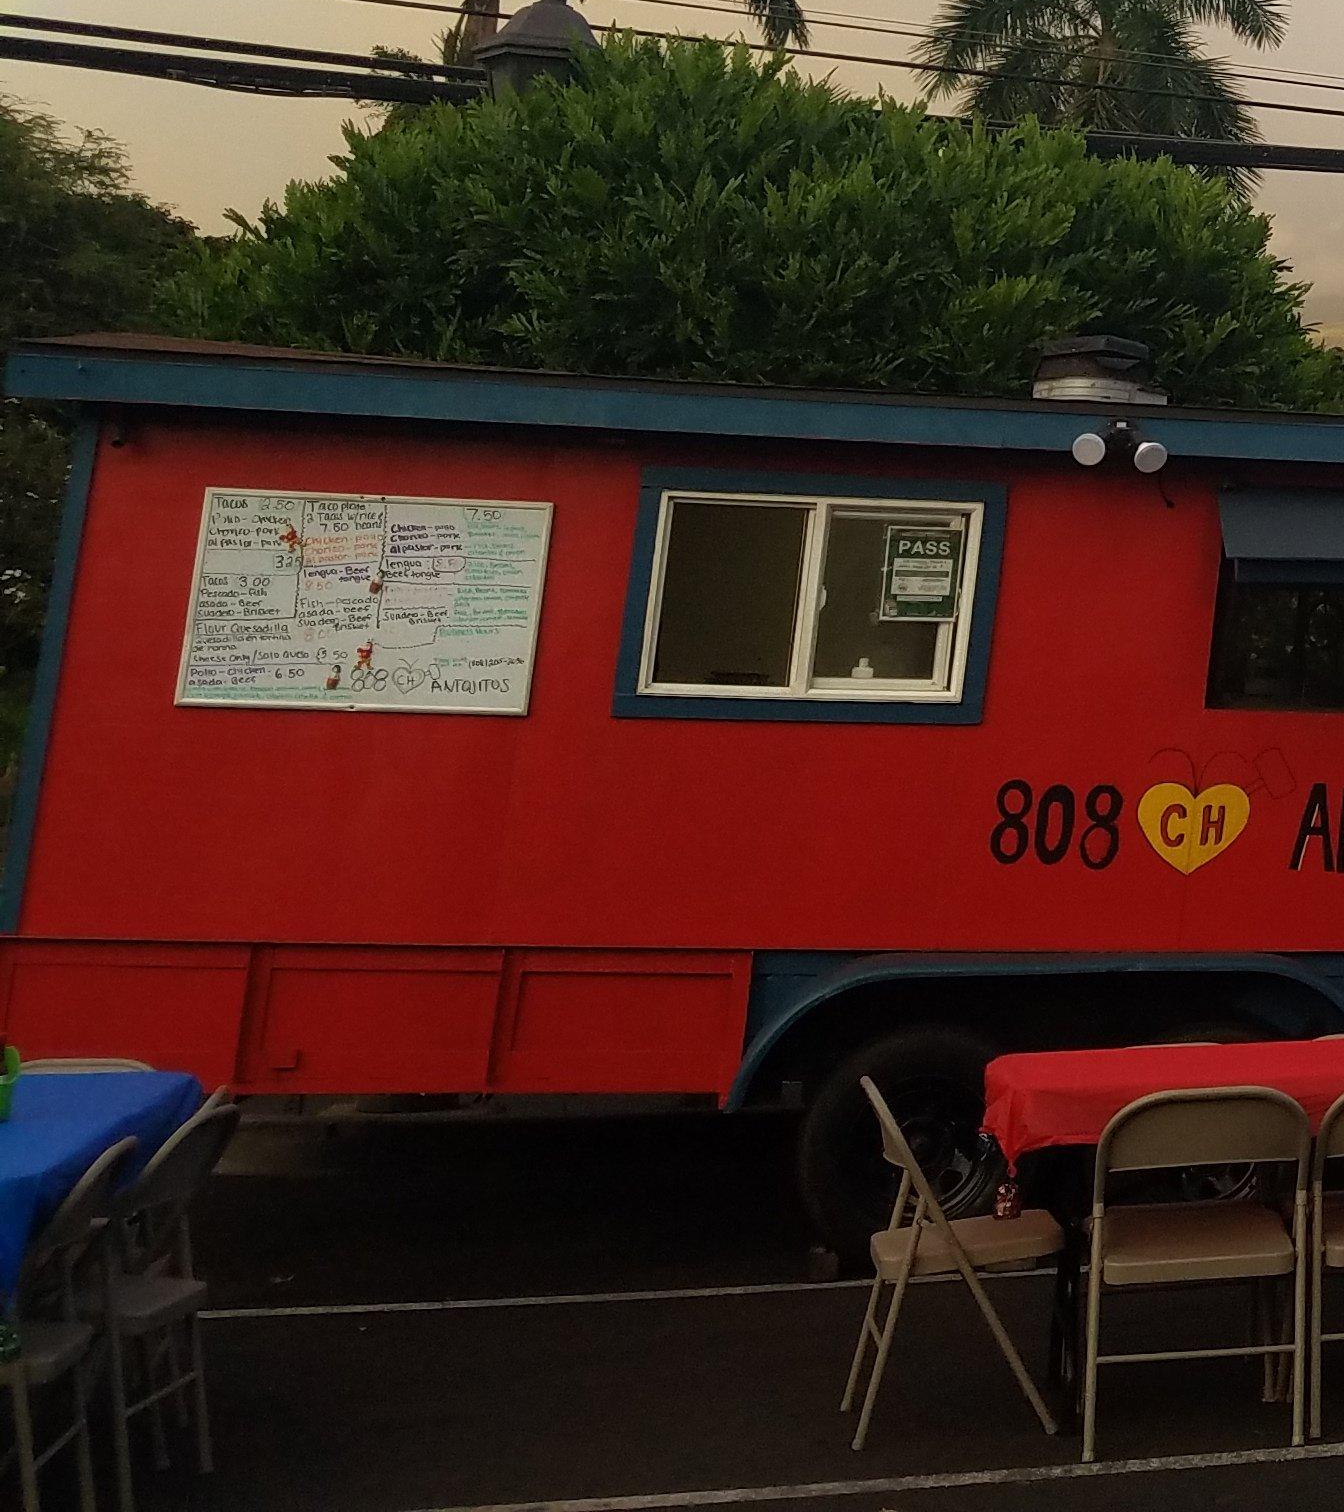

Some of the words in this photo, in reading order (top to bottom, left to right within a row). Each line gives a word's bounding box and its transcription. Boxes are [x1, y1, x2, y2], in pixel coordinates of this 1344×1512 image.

[898, 540, 951, 556] PASS
[990, 779, 1124, 871] 808
[1160, 802, 1227, 847] CH
